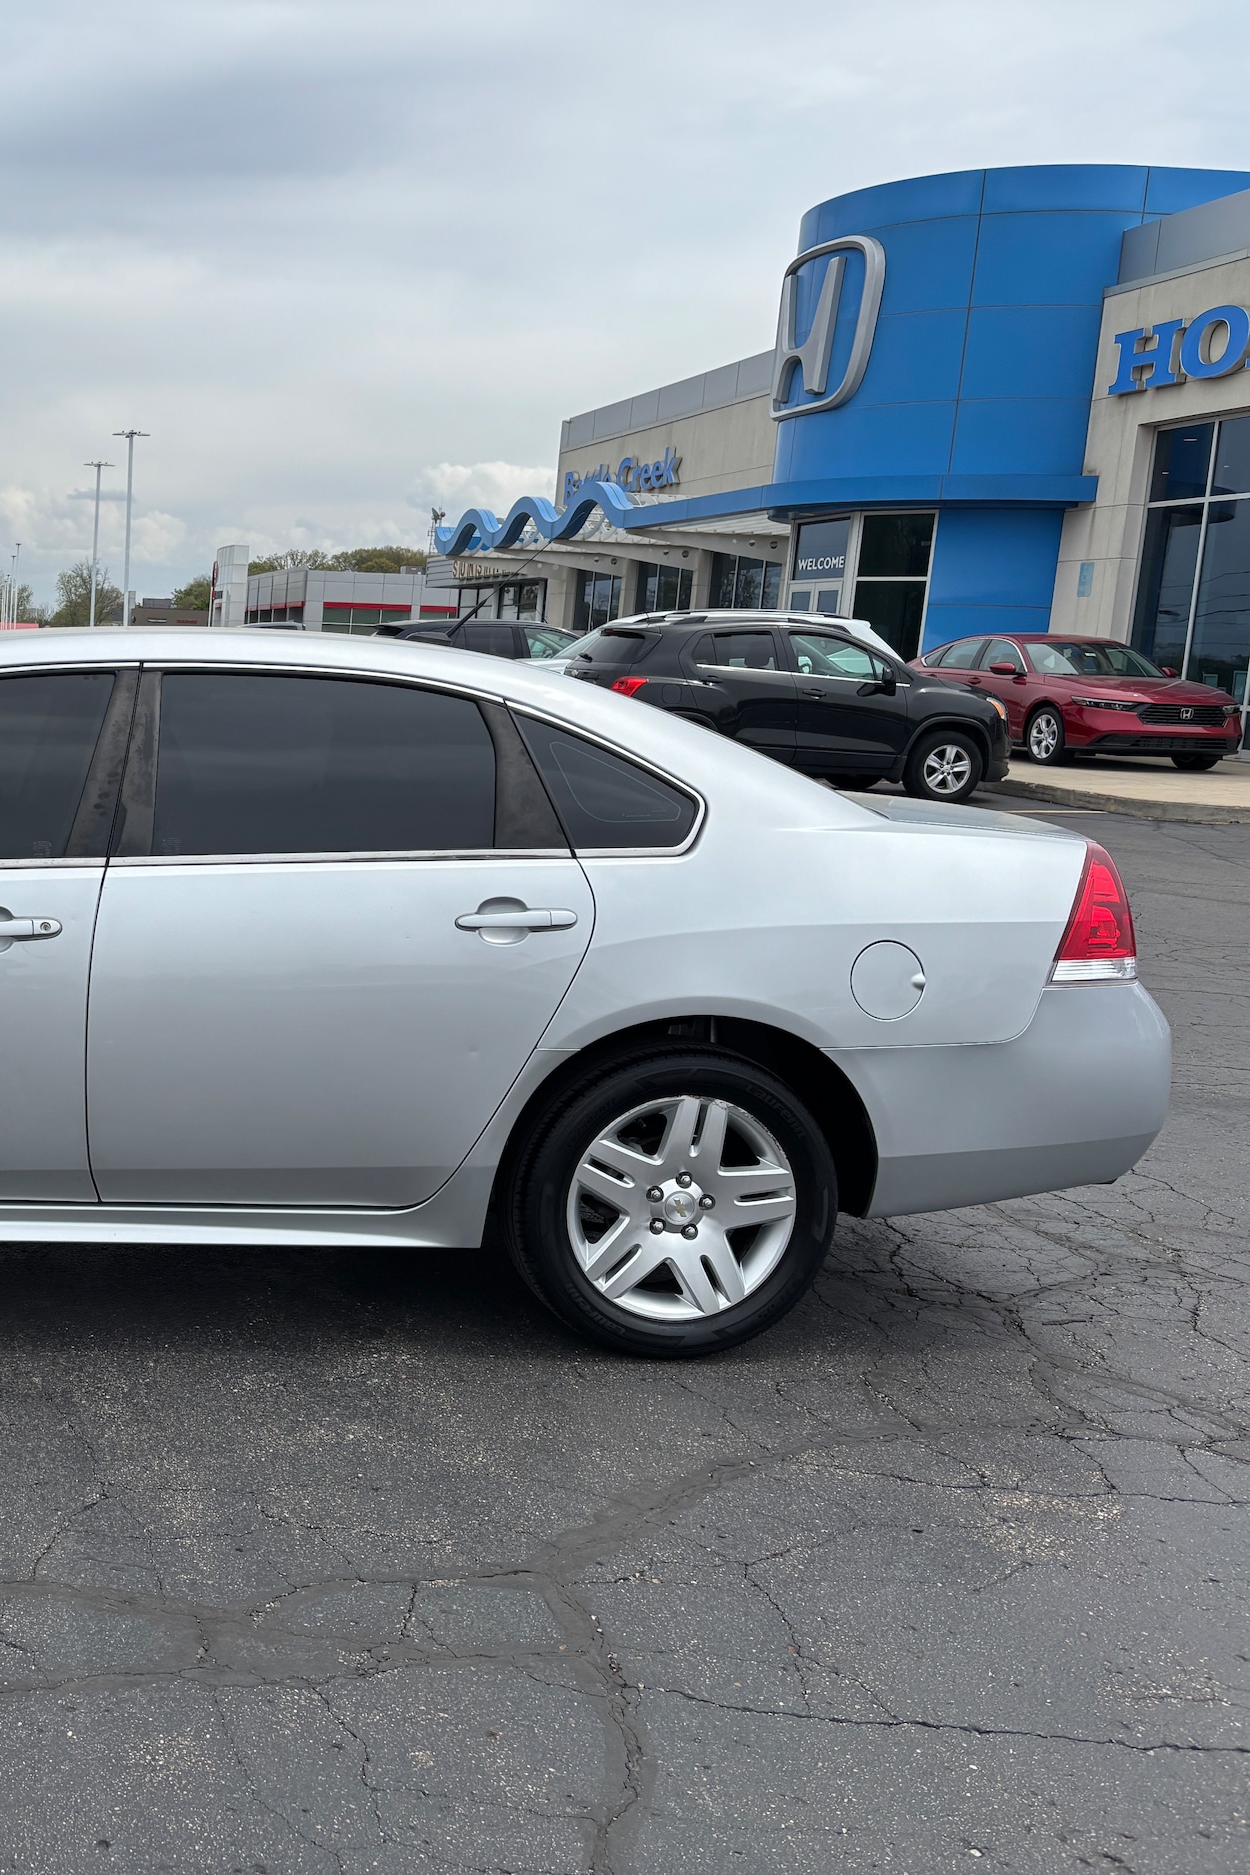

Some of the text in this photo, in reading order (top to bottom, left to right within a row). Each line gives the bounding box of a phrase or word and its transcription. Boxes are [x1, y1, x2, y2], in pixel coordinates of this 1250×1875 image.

[1108, 304, 1250, 396] HO
[616, 447, 679, 493] Creek
[798, 555, 846, 572] WELCOME
